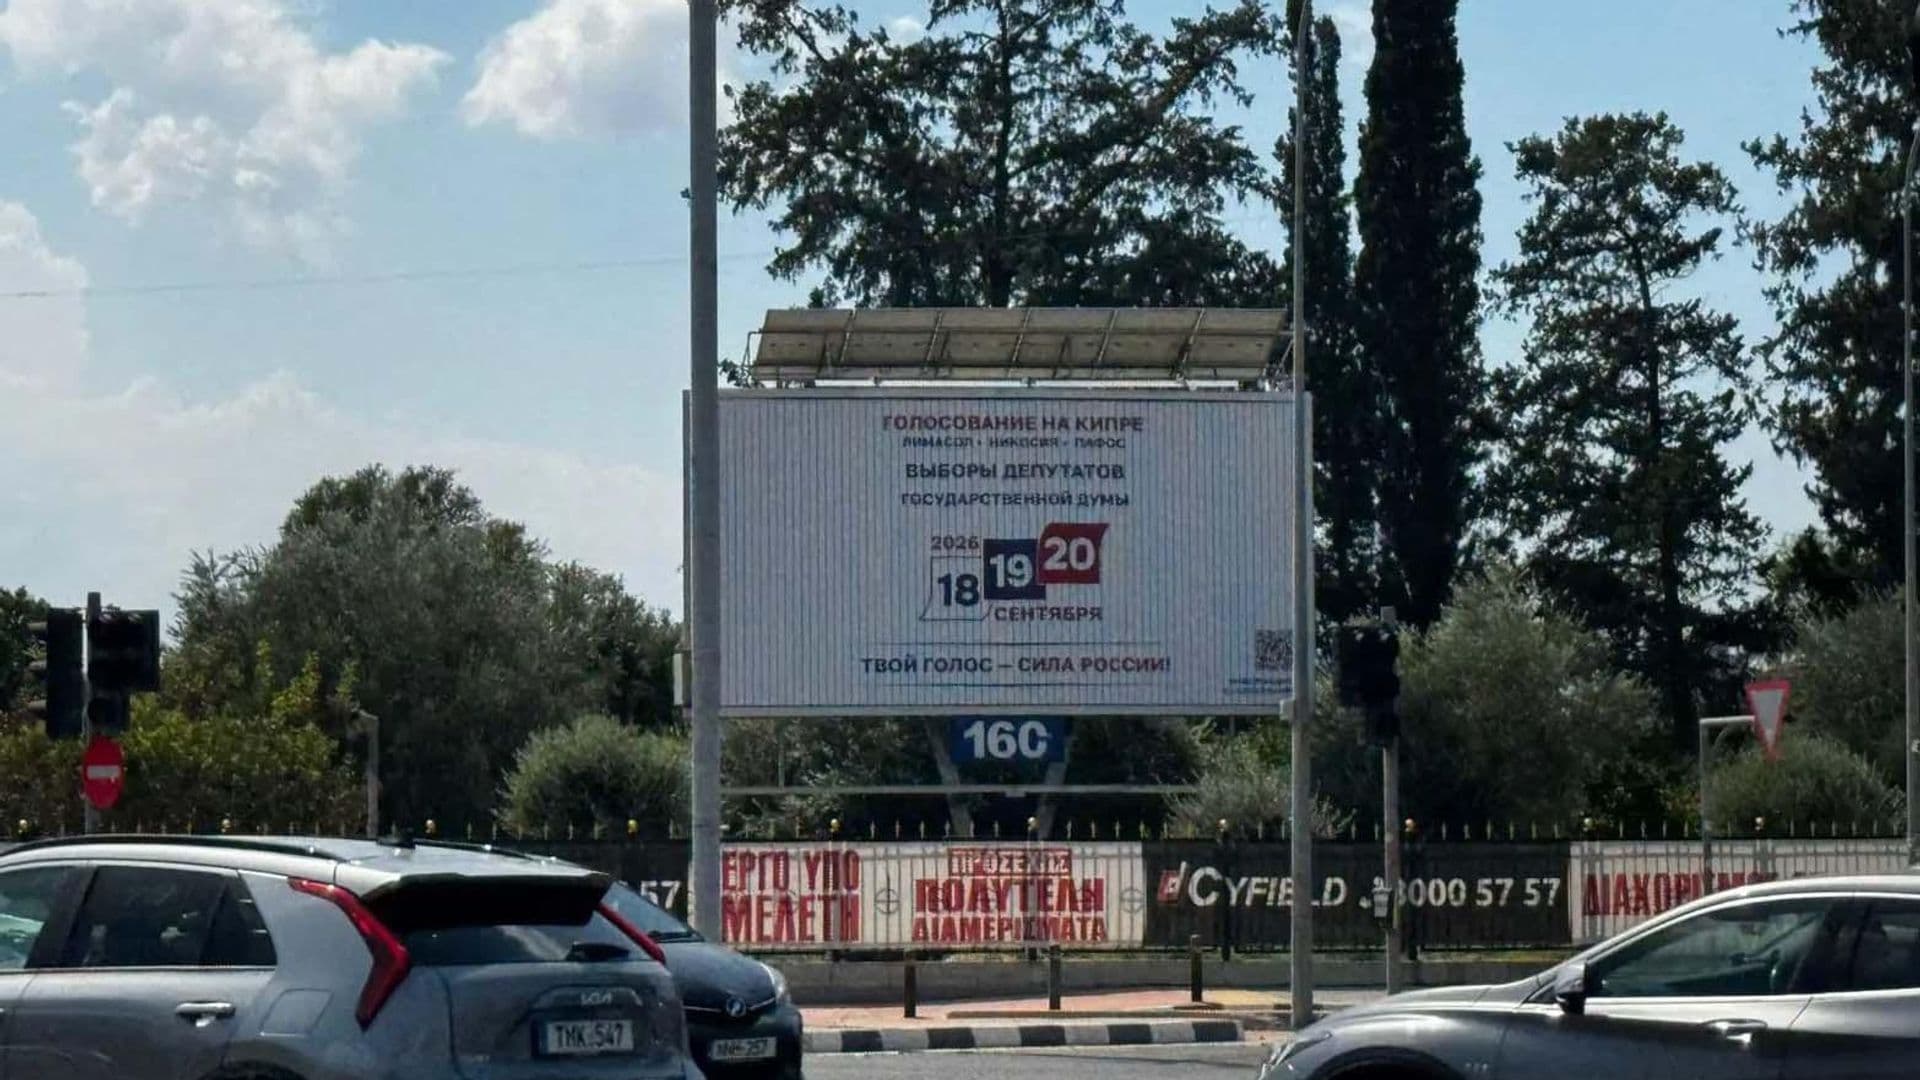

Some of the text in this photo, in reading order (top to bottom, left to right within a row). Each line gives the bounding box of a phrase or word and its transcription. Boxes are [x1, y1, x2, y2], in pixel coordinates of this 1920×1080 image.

[882, 415, 1144, 431] ГОЛОСОВАНИЕ НА КИПРЕ
[902, 436, 974, 449] ЛИМАСОЛ
[1074, 437, 1126, 449] ПАФОС
[905, 463, 1125, 481] ВЫБОРЫ ДЕПУТАТОВ
[901, 491, 1129, 507] ГОСУДАРСТВЕННОЙ ДУМЫ
[931, 535, 980, 550] 2026
[1044, 536, 1095, 571] 20
[989, 553, 1033, 588] 19
[937, 573, 980, 607] 18
[994, 606, 1104, 622] СЕНТЯБРЯ
[862, 654, 918, 673] ТВОЙ
[923, 657, 993, 673] ГОЛОС
[1018, 656, 1075, 673] СИЛА
[1080, 656, 1171, 673] РОССИИ!
[721, 850, 861, 891] ΕΡΓΟ ΥΠΟ
[1475, 877, 1514, 907] 57
[1523, 877, 1561, 907] 57
[721, 894, 860, 942] ΜΕΛΕΤΗ
